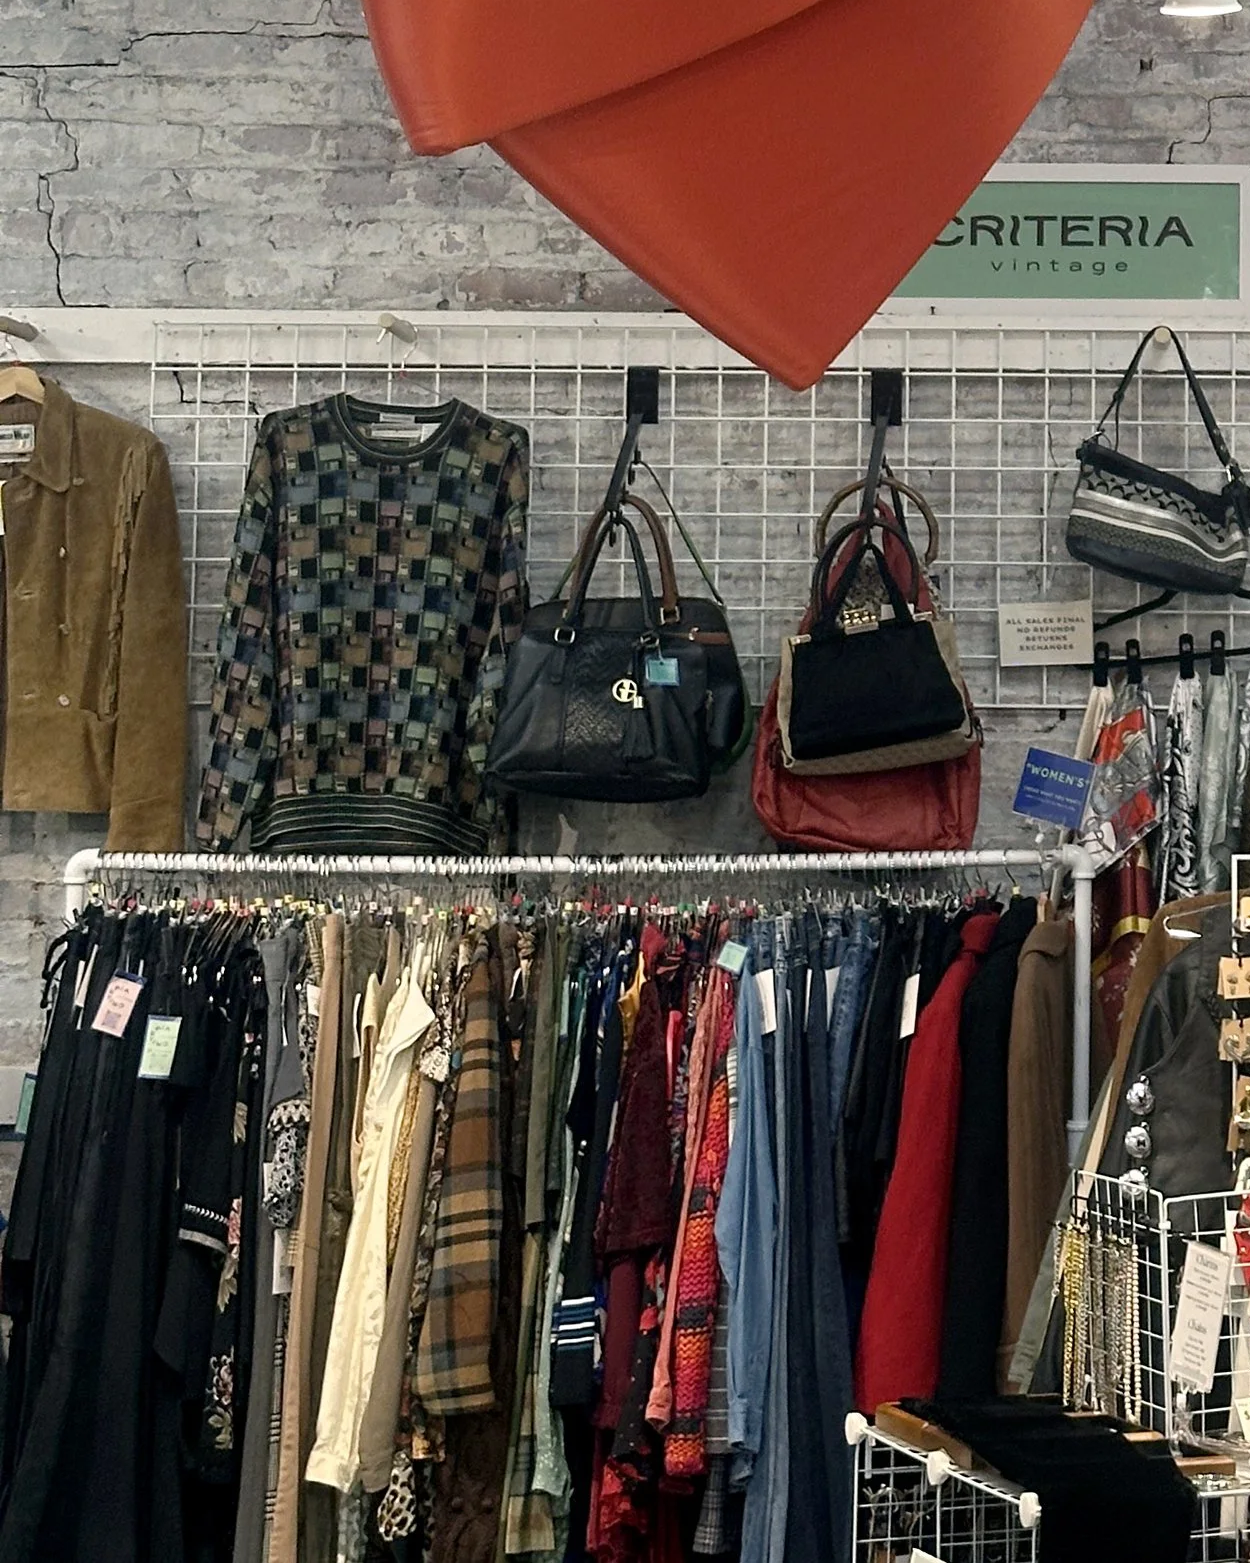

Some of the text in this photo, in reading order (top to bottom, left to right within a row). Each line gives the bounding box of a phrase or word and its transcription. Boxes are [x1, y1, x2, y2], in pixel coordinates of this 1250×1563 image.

[933, 214, 1194, 247] CRITERIA
[990, 257, 1130, 276] vintage
[1016, 626, 1031, 634] NO
